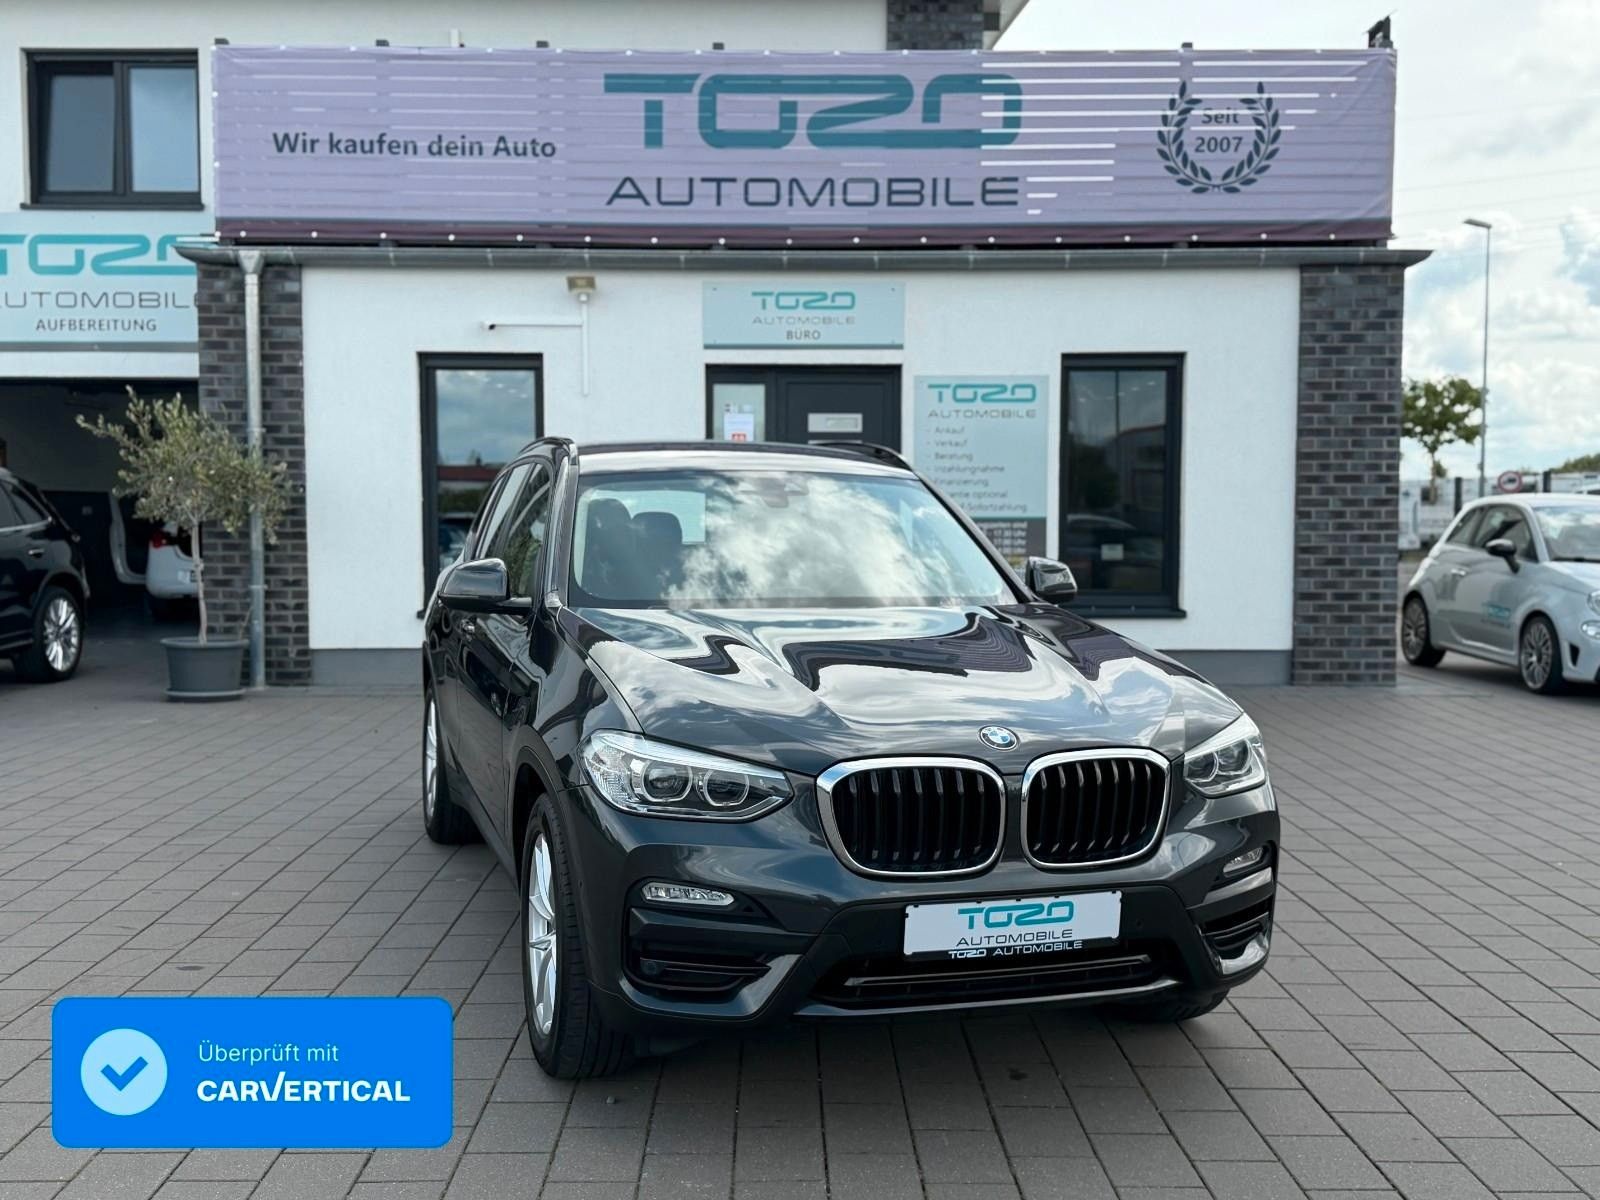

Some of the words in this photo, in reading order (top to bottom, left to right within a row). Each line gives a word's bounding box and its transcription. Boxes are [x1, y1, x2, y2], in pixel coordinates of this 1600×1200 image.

[604, 73, 1023, 149] TOZO
[1201, 107, 1240, 124] Seit
[272, 131, 320, 154] Wir
[328, 131, 419, 156] kaufen
[428, 134, 485, 157] dein
[492, 135, 558, 158] Auto
[1194, 136, 1244, 153] 2007
[605, 176, 1020, 207] AUTOMOBILE
[0, 291, 198, 309] UTOMOBIL
[751, 291, 856, 311] TOZO
[35, 318, 158, 332] AUFBEREITUNG
[751, 316, 856, 325] AUTOMOBILE
[927, 383, 1037, 403] TOZO
[927, 409, 1037, 419] AUTOMOBILE
[935, 439, 968, 447] Verkauf
[957, 900, 1075, 930] TOZO
[955, 928, 1074, 948] AUTOMOBILE
[992, 940, 1084, 957] AUTOMOBILE
